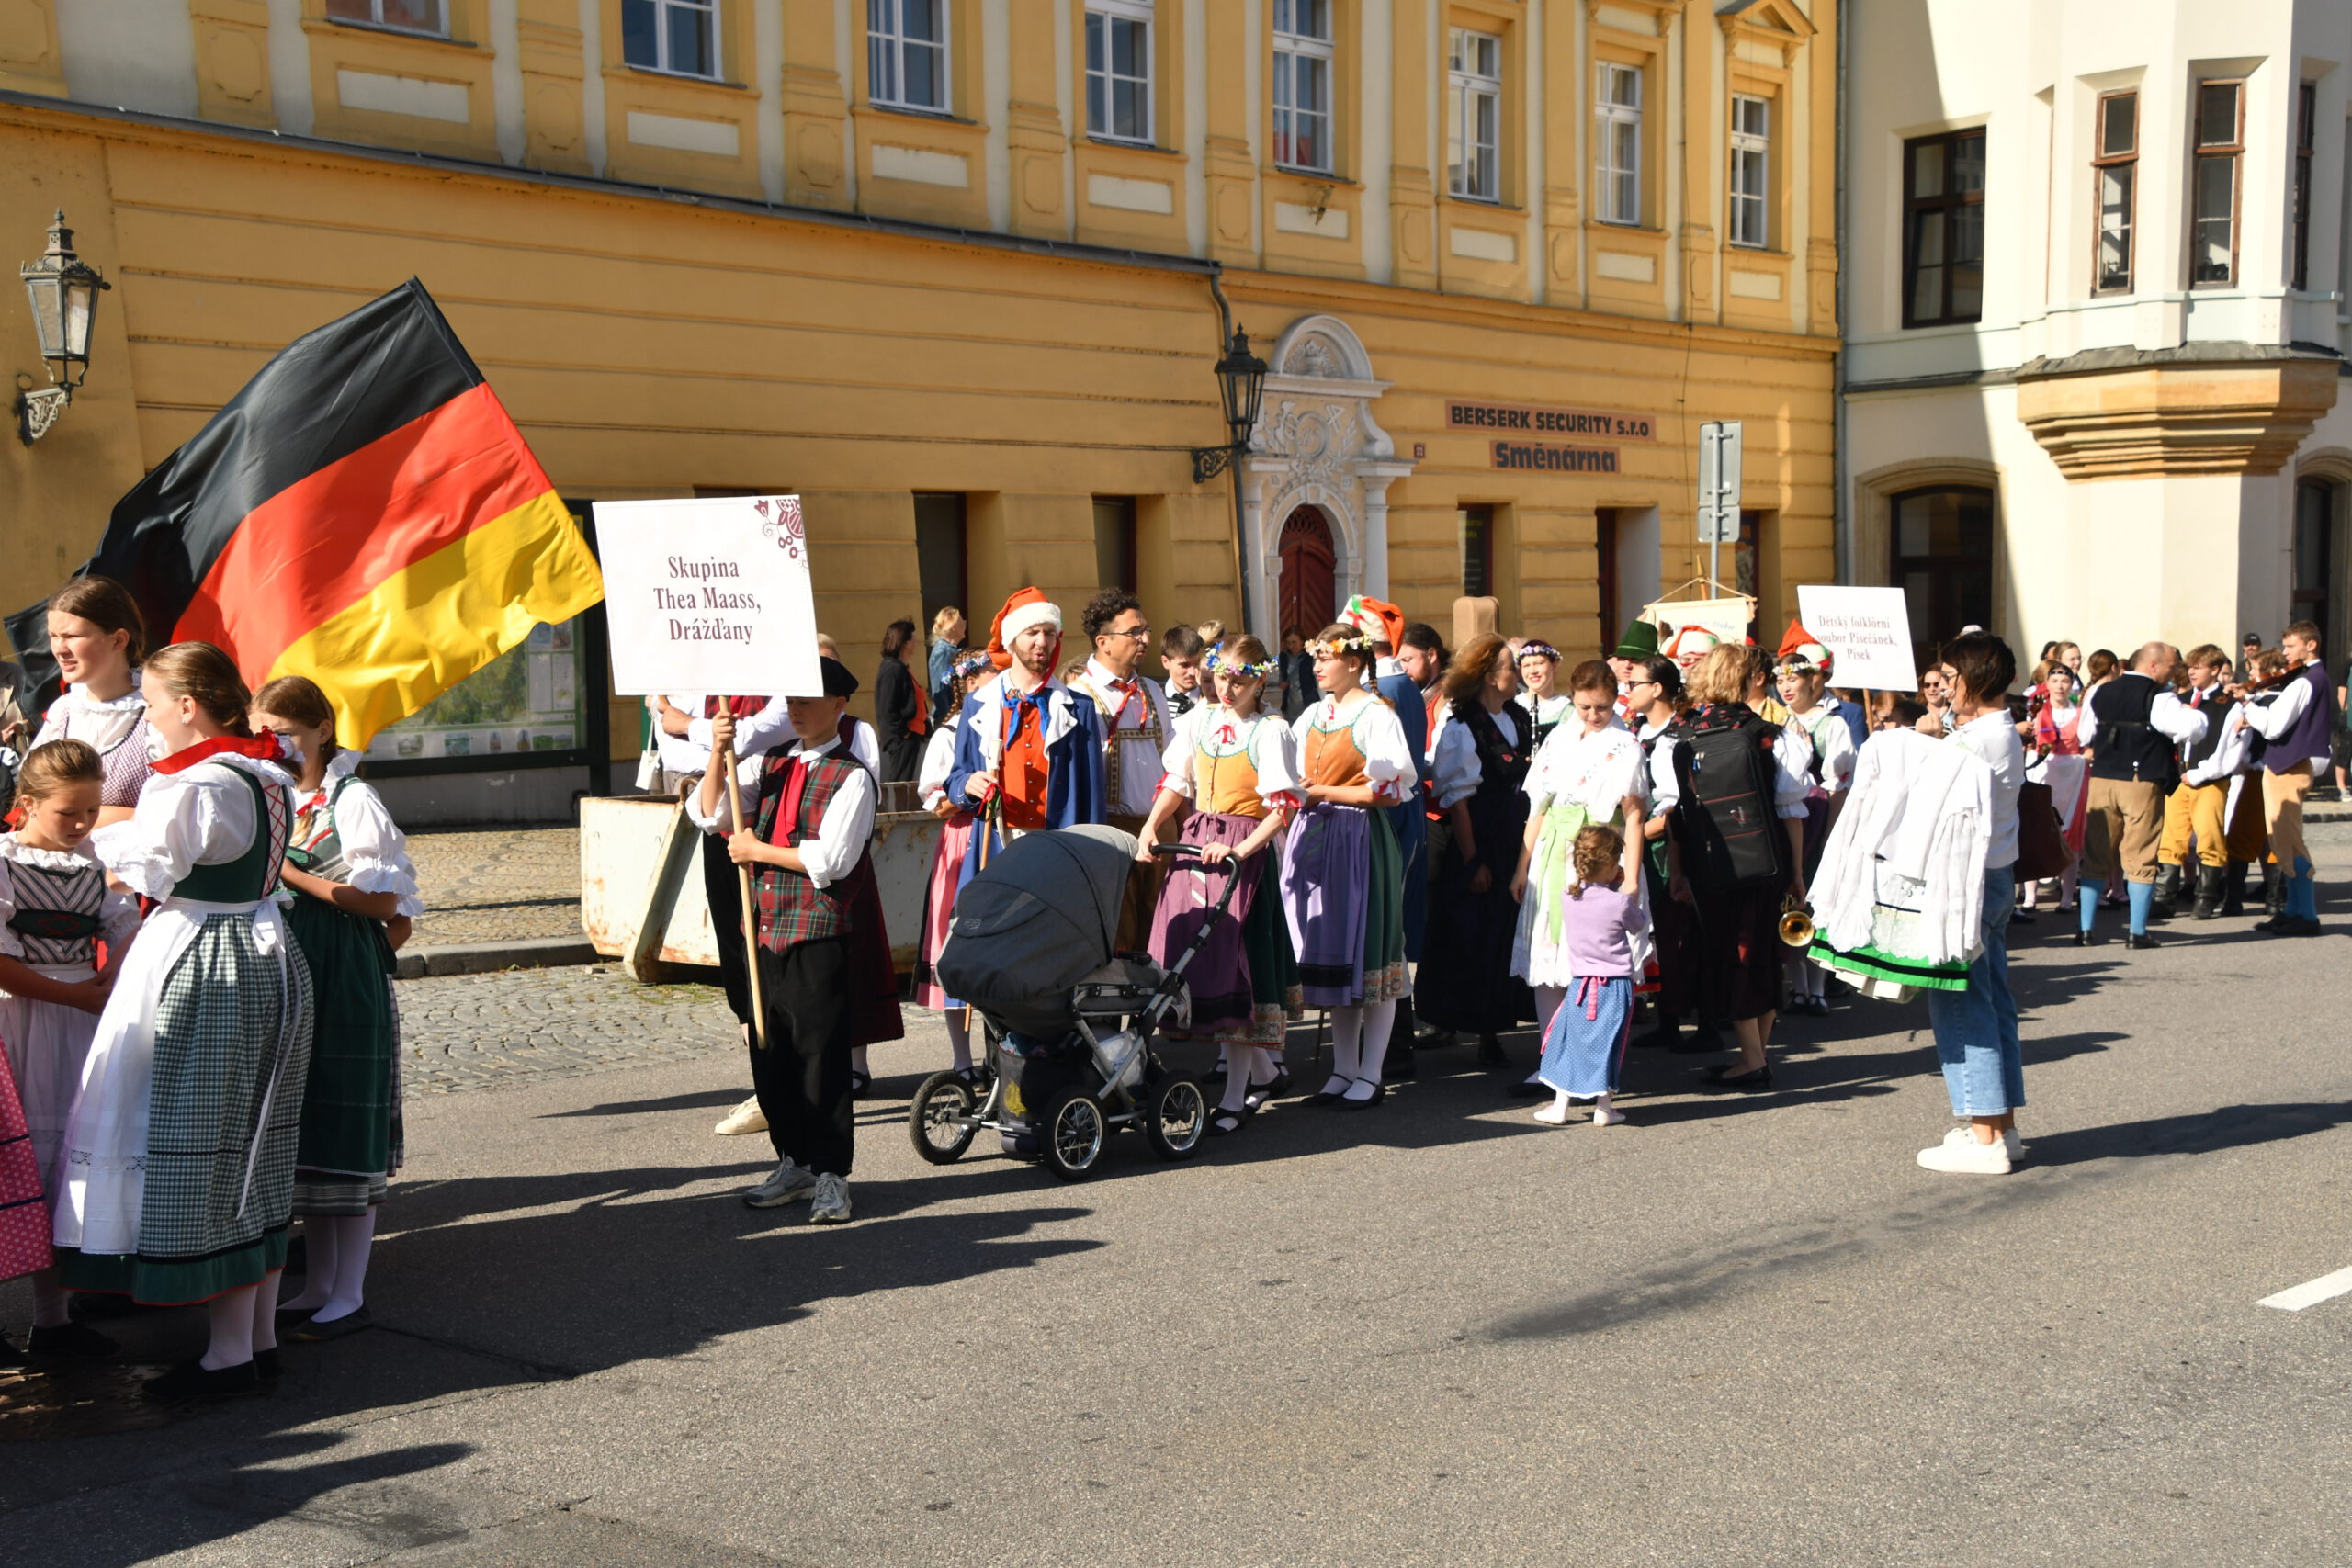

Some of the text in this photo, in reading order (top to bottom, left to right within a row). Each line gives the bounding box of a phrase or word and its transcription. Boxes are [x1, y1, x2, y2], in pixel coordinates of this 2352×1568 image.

[1451, 405, 1650, 437] BERSERK SECURITY s.r.o
[1495, 442, 1616, 472] Směnárna
[668, 556, 740, 582] Skupina
[653, 586, 762, 614] Thea Maass,
[669, 617, 753, 645] Drážďany
[1847, 648, 1871, 660] Písek
